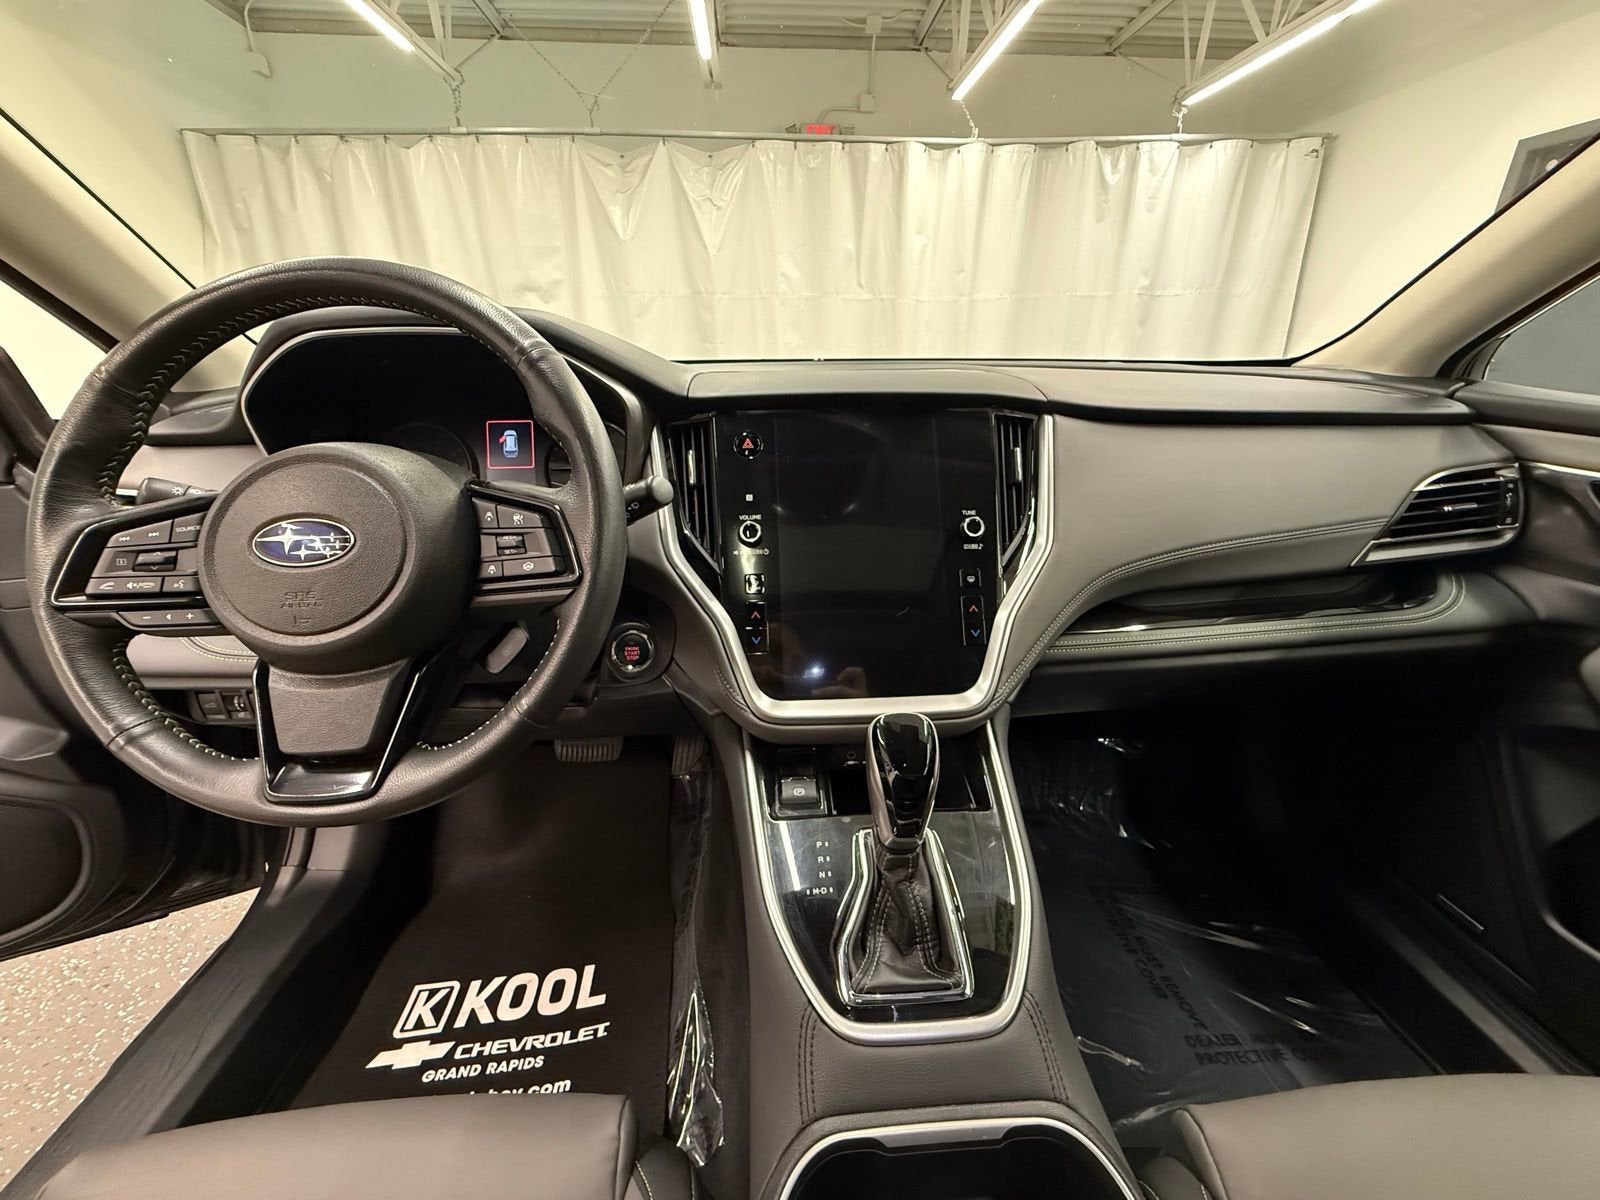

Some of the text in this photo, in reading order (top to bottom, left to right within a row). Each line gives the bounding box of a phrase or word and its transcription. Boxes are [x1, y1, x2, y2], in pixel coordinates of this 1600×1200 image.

[816, 841, 823, 849] P
[817, 856, 824, 864] R
[818, 871, 826, 879] N
[453, 964, 607, 1029] KOOL
[454, 1022, 610, 1060] CHEVROLET
[1184, 1033, 1243, 1048] DEALER
[421, 1055, 545, 1083] GRAND RAPIDS
